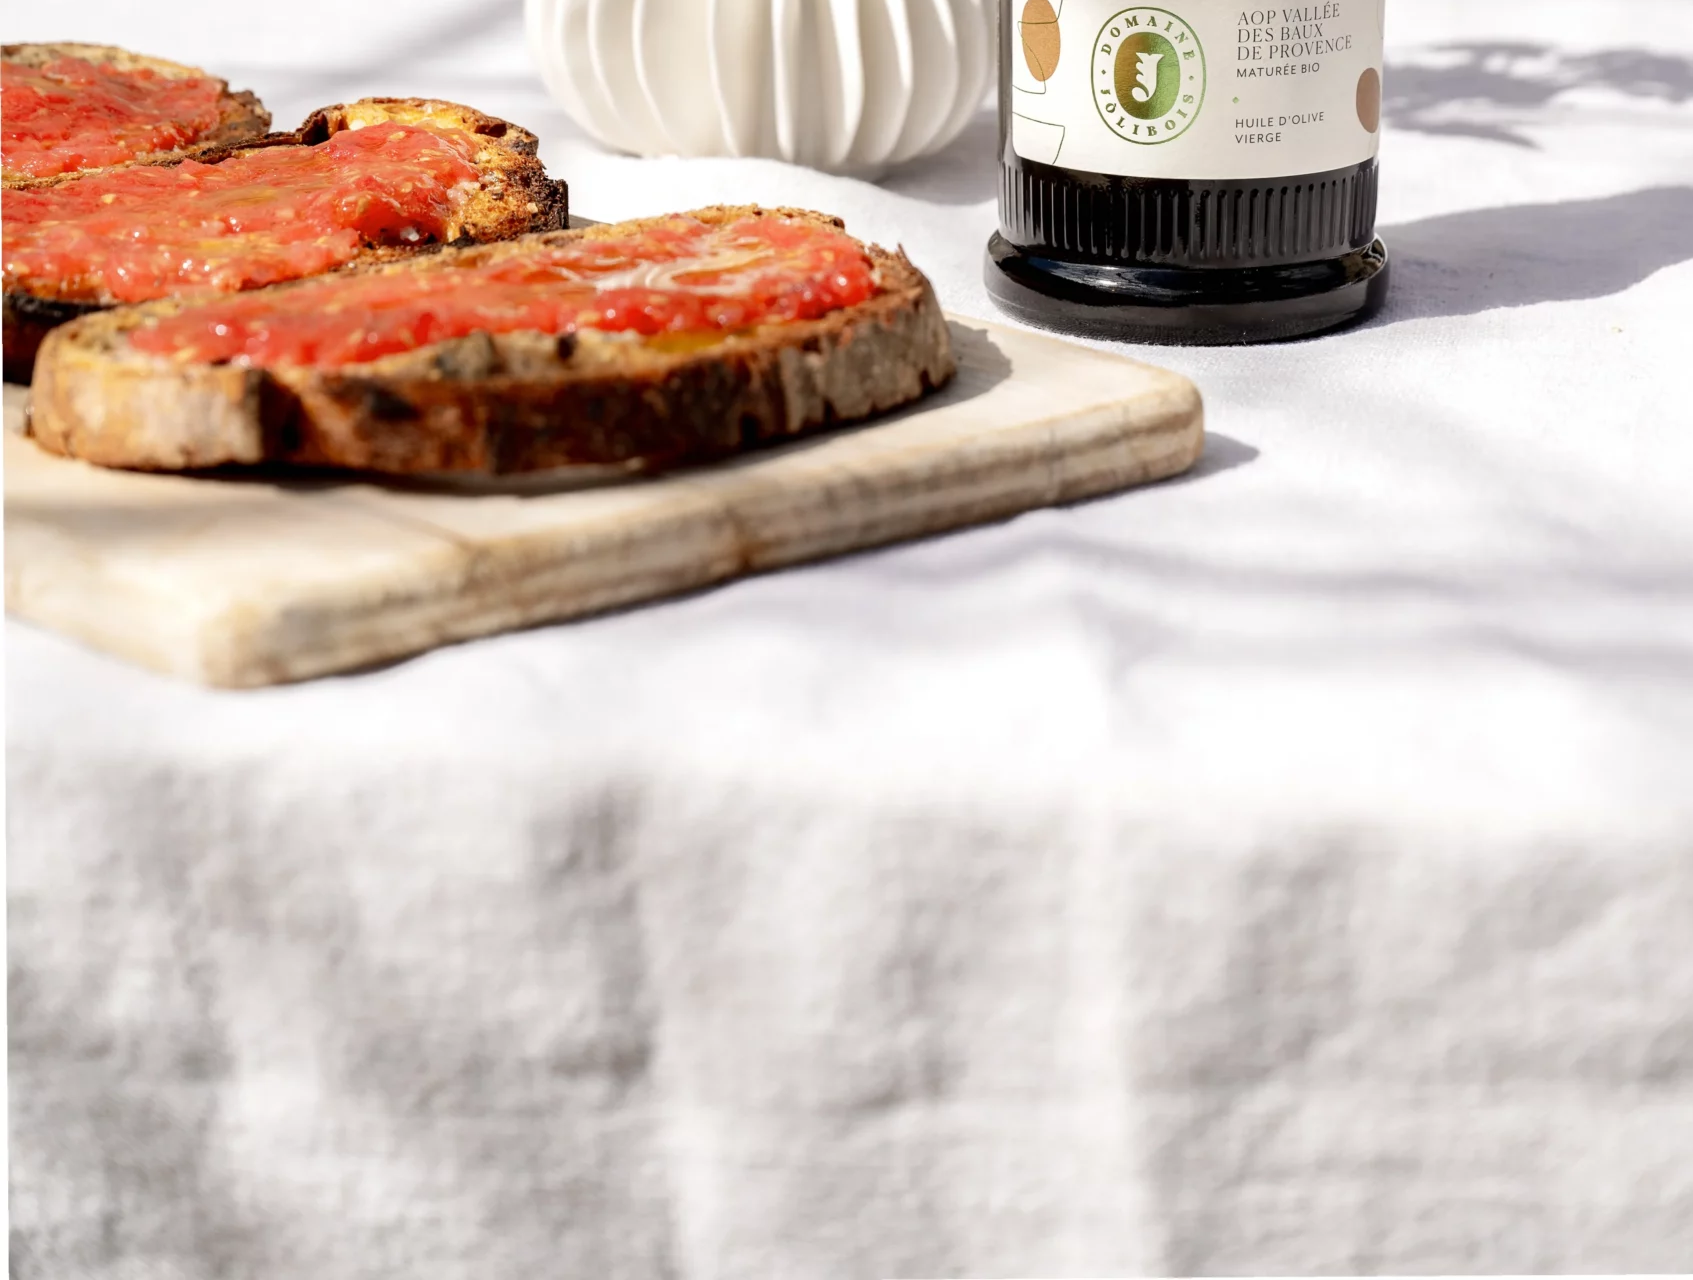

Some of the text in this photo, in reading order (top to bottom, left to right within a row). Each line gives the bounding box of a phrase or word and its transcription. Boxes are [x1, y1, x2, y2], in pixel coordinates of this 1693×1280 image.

[1237, 1, 1340, 26] AOP VALLÉE
[1101, 15, 1196, 60] DOMAINE
[1237, 23, 1323, 43] DES BAUX
[1237, 35, 1352, 61] DE PROVENCE
[1236, 62, 1320, 78] MATURÉE BIO
[1235, 111, 1324, 129] HUILE D'OLIVE
[1235, 132, 1282, 144] VIERGE
